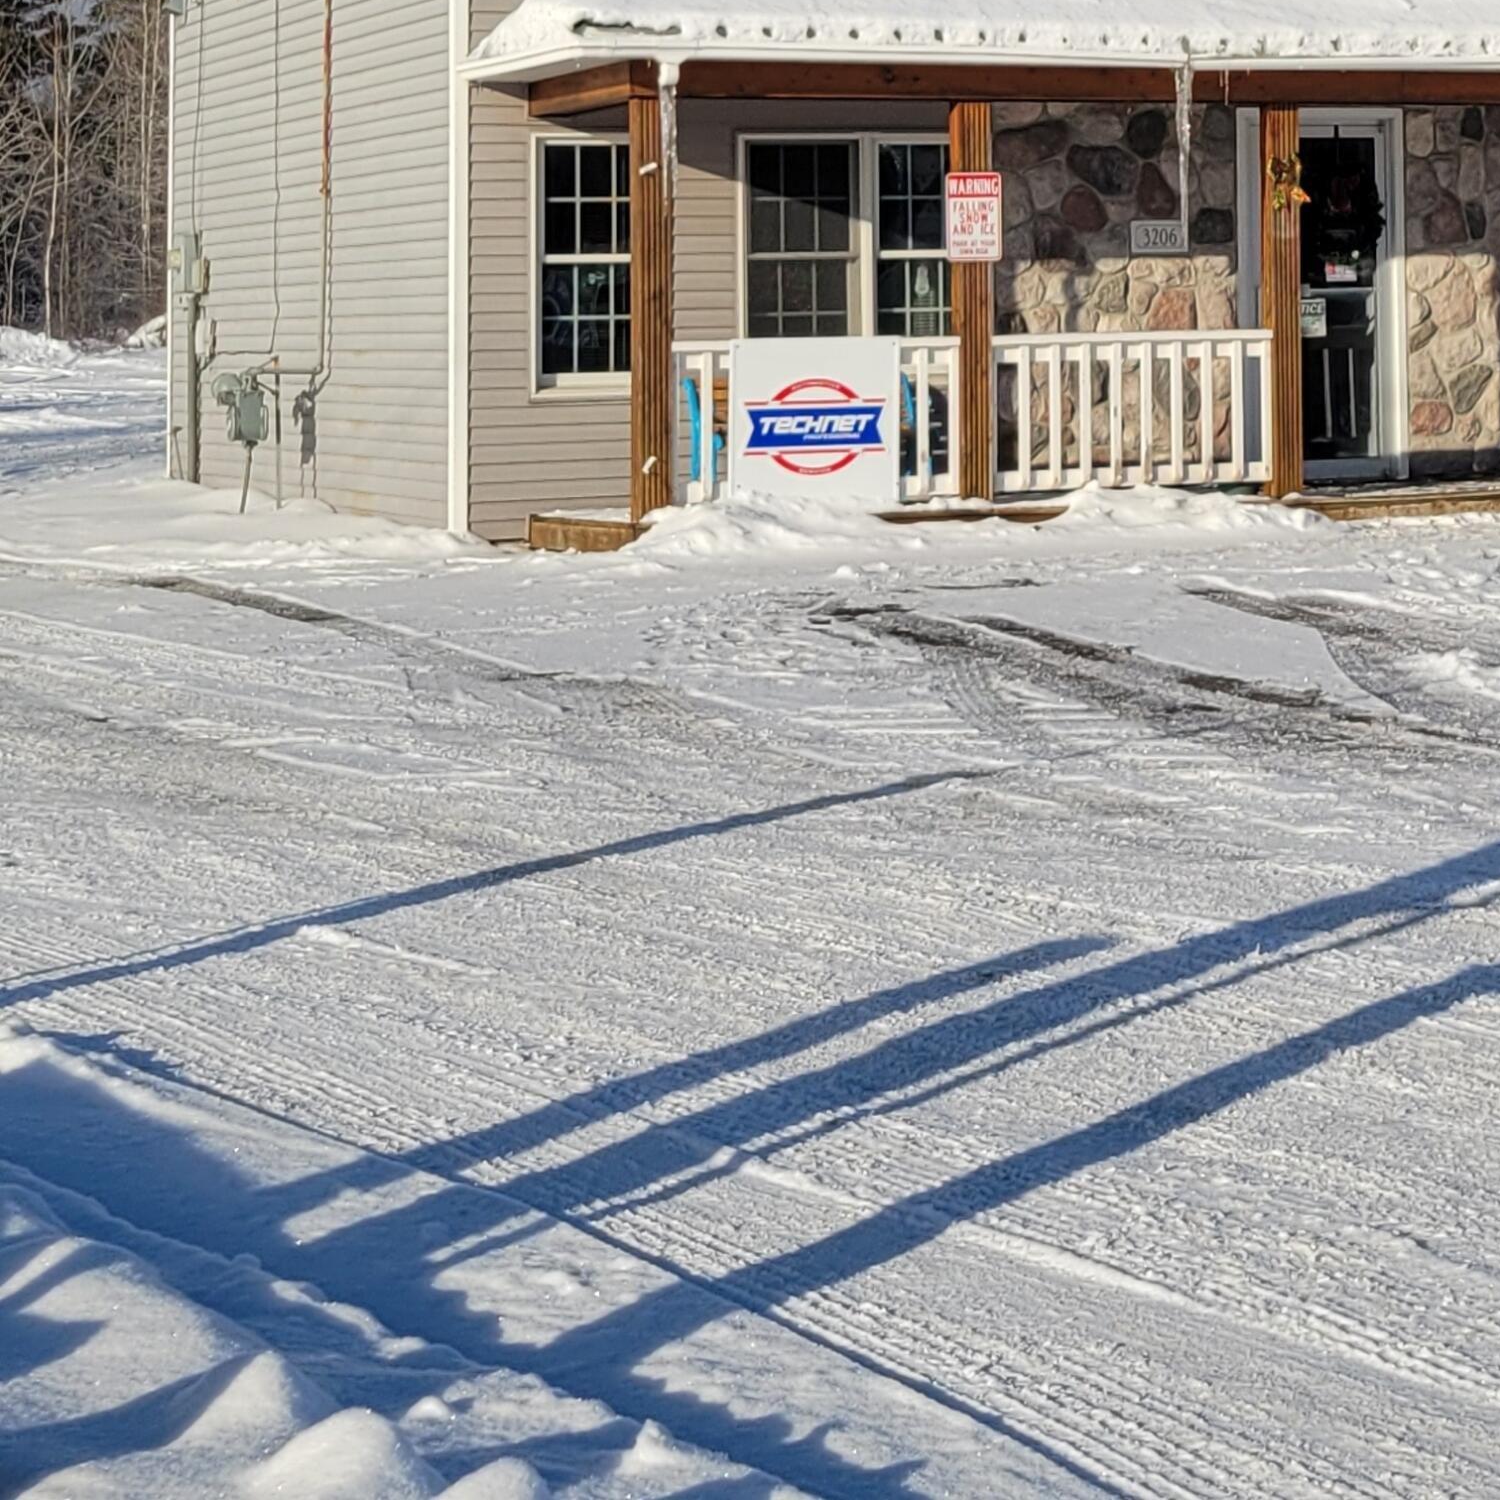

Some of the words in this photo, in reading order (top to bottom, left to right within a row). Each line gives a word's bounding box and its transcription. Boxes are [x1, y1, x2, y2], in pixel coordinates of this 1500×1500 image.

[949, 178, 999, 195] WARNING
[952, 200, 994, 213] FALLING
[959, 211, 989, 224] SNOW
[952, 223, 974, 235] AND
[980, 223, 996, 235] ICE
[1143, 227, 1178, 245] 3206
[1301, 302, 1324, 315] TICE
[759, 413, 876, 437] TECHNET
